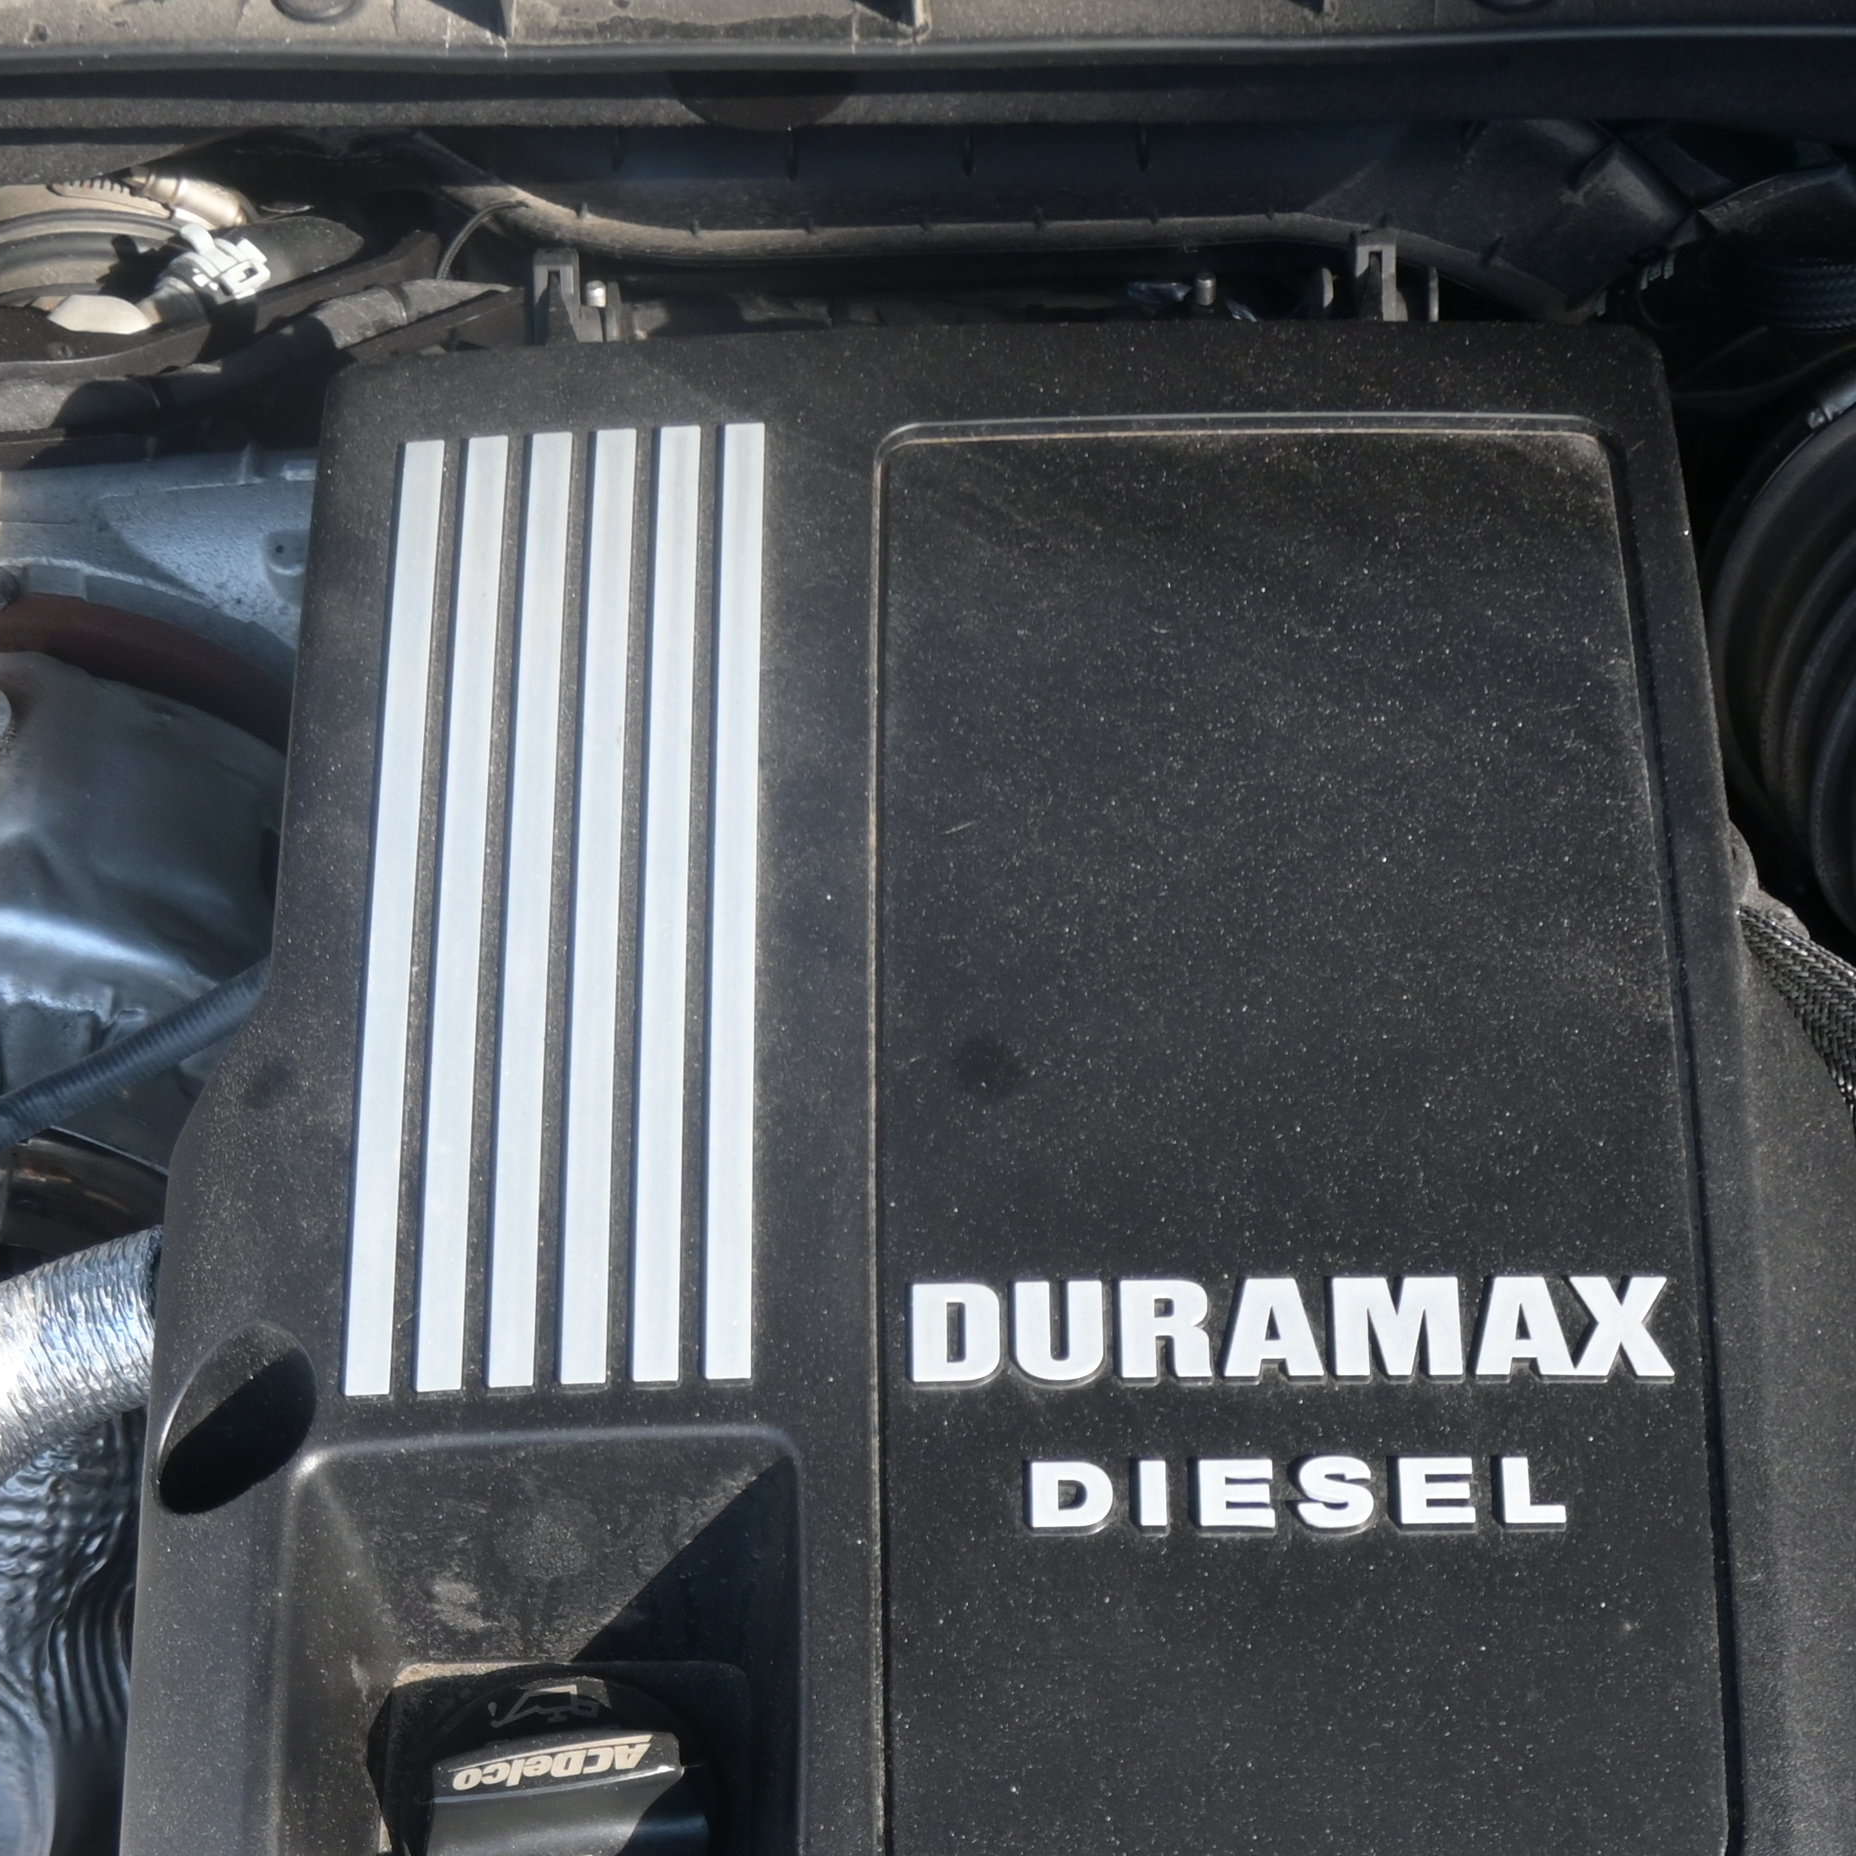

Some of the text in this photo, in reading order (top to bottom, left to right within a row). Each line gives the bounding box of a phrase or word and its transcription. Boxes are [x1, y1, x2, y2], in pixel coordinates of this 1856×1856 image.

[910, 1274, 1675, 1385] DURAMAX
[1025, 1455, 1568, 1533] DIESEL
[451, 1740, 650, 1791] ACDelco
